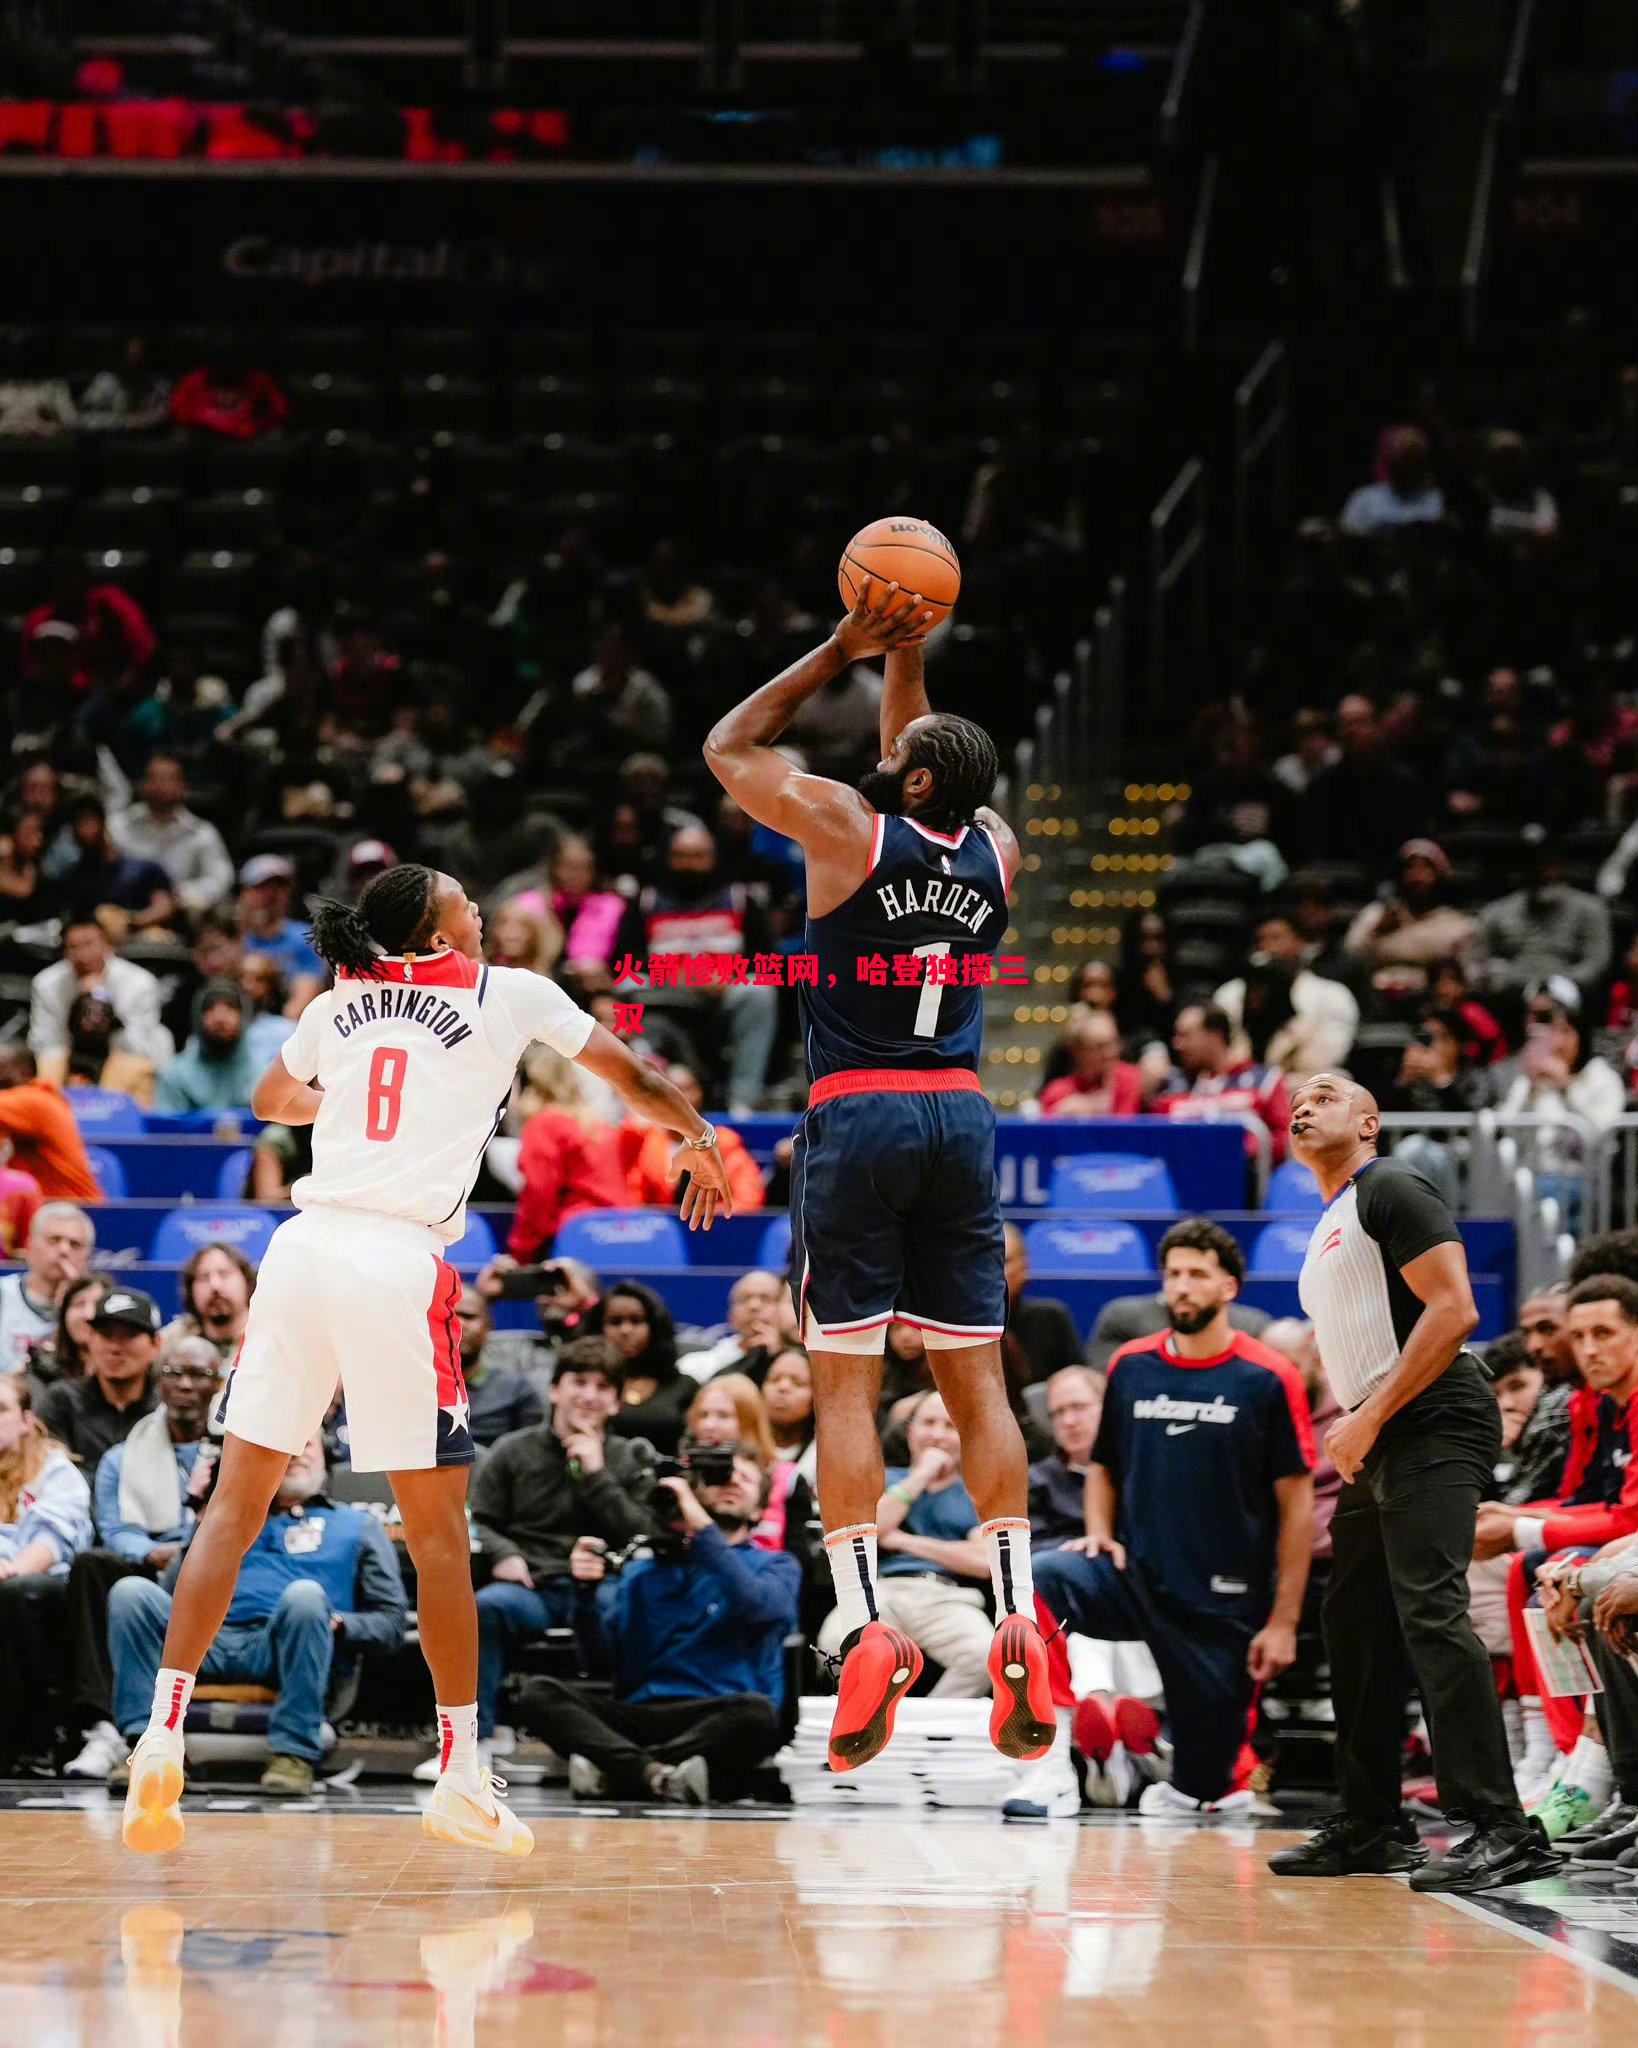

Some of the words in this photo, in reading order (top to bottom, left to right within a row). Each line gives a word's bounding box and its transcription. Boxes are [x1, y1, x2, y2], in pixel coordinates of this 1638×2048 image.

[876, 878, 994, 935] HARDEN
[333, 988, 473, 1050] CARRINGTON
[912, 941, 951, 1038] 1
[365, 1046, 409, 1143] 8
[1133, 1393, 1240, 1424] wizards
